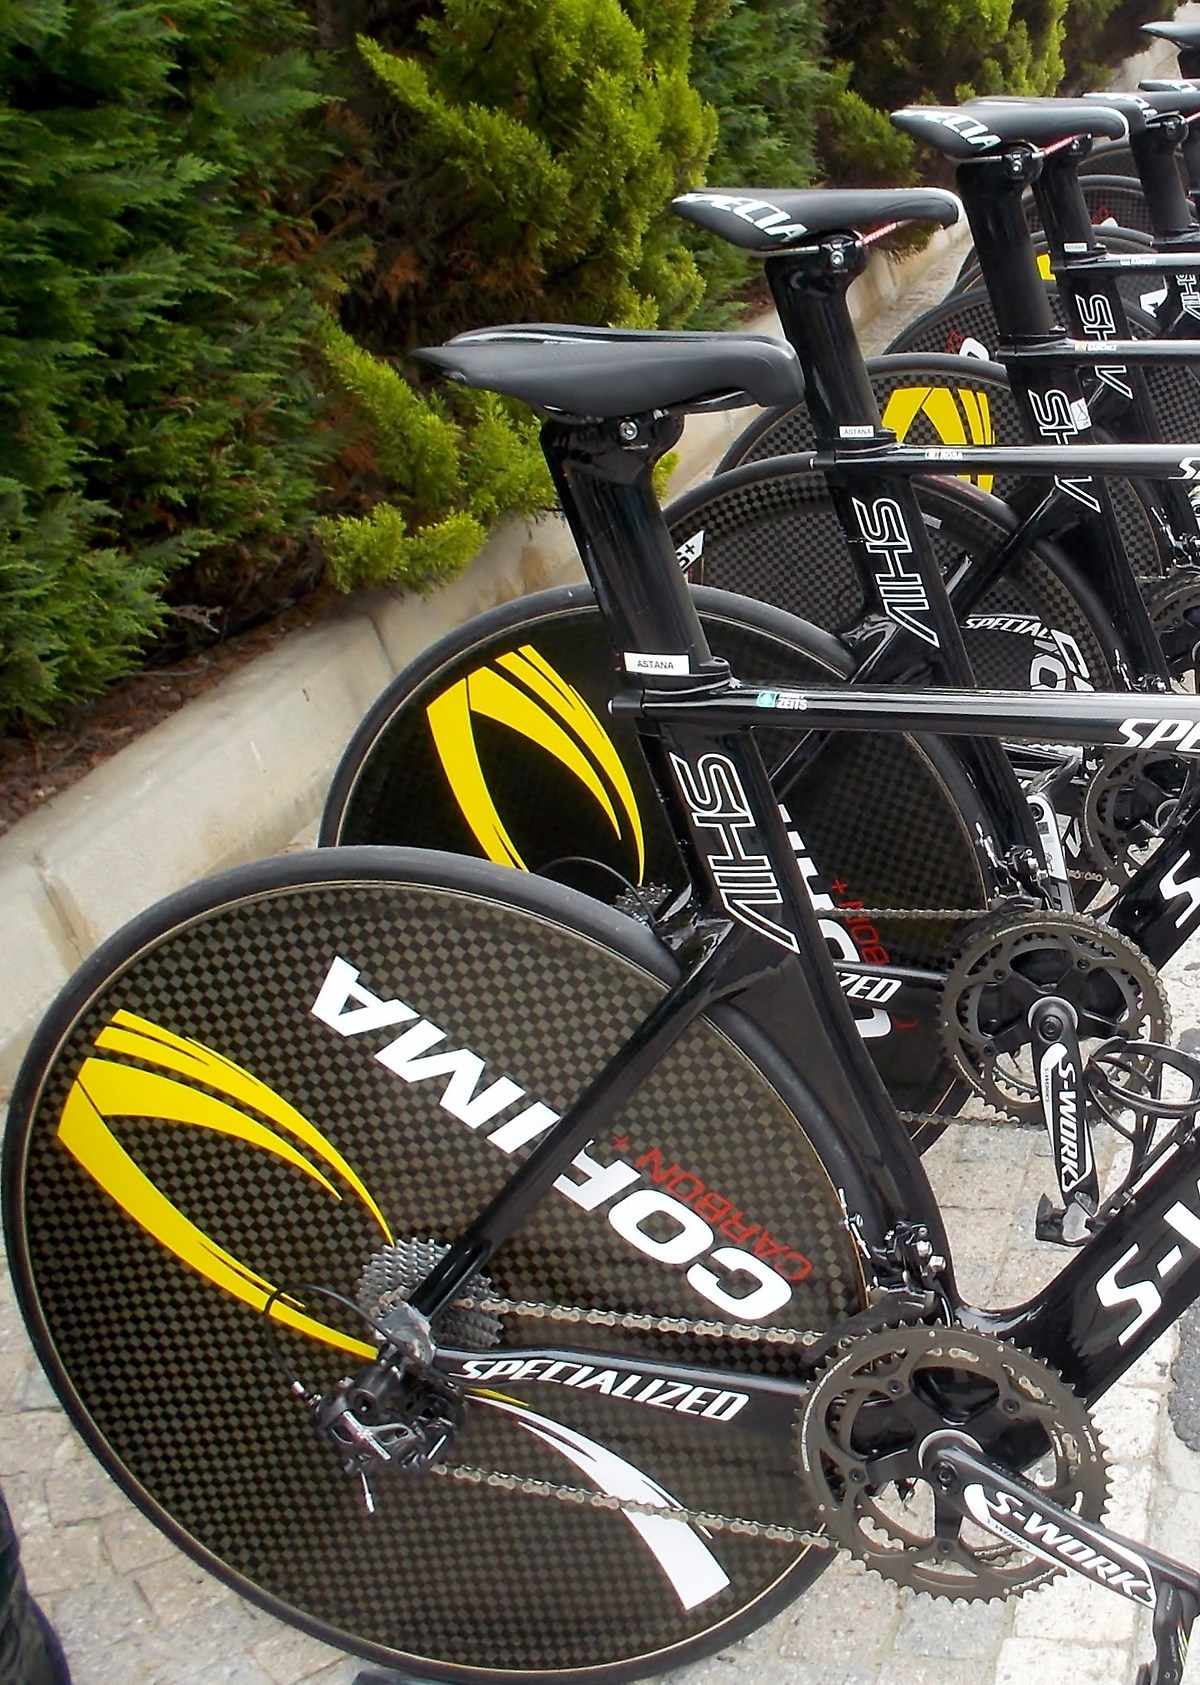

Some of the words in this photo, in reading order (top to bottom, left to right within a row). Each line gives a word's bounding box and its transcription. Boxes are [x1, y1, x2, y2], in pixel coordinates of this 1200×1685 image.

[843, 428, 872, 436] ASTANA
[851, 496, 941, 649] SHIV
[637, 659, 675, 670] ASTANA
[670, 751, 802, 955] SHIV
[634, 1147, 813, 1283] CARBON
[450, 1357, 751, 1423] SPECIALIZED
